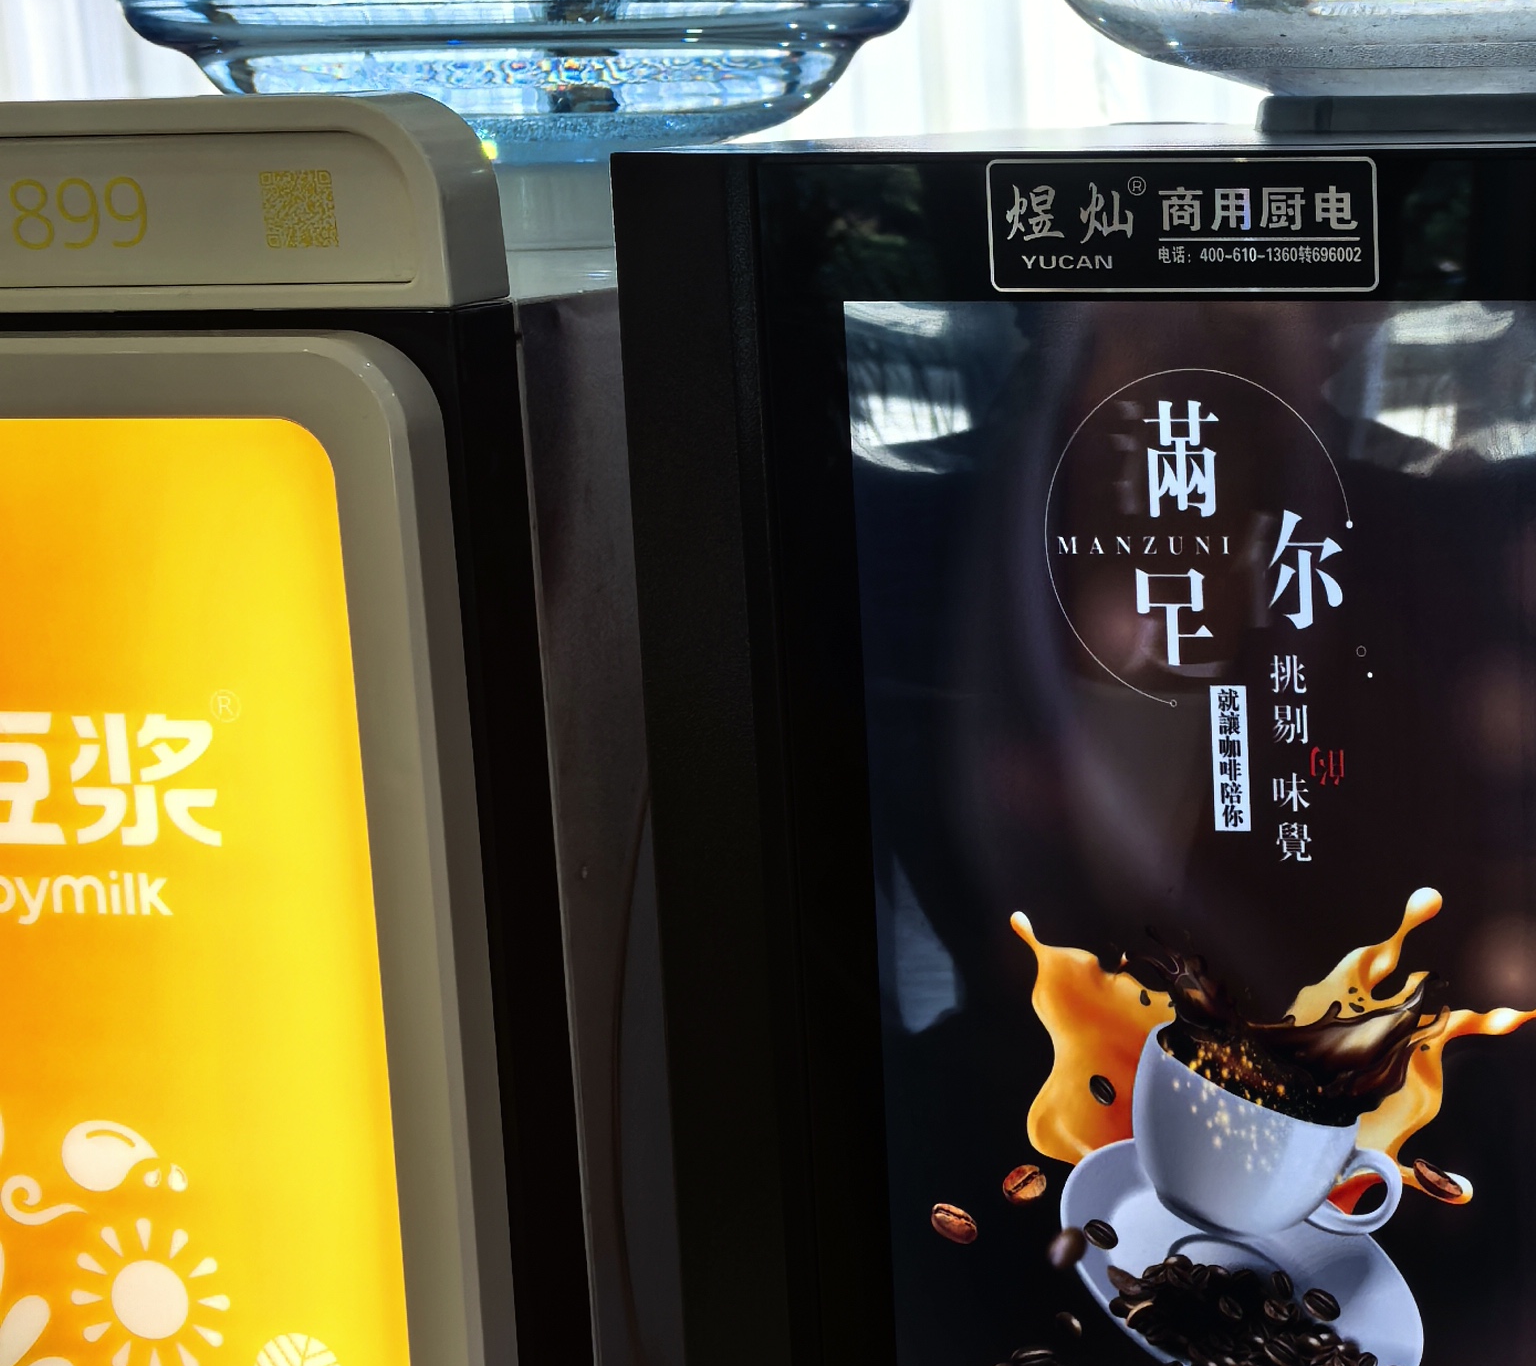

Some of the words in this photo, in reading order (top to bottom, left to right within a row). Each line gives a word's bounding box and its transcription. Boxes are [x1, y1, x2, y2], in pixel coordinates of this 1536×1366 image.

[1158, 185, 1359, 232] 商用厨电
[1022, 255, 1113, 270] YUCAN
[1057, 535, 1232, 556] MANZUNI
